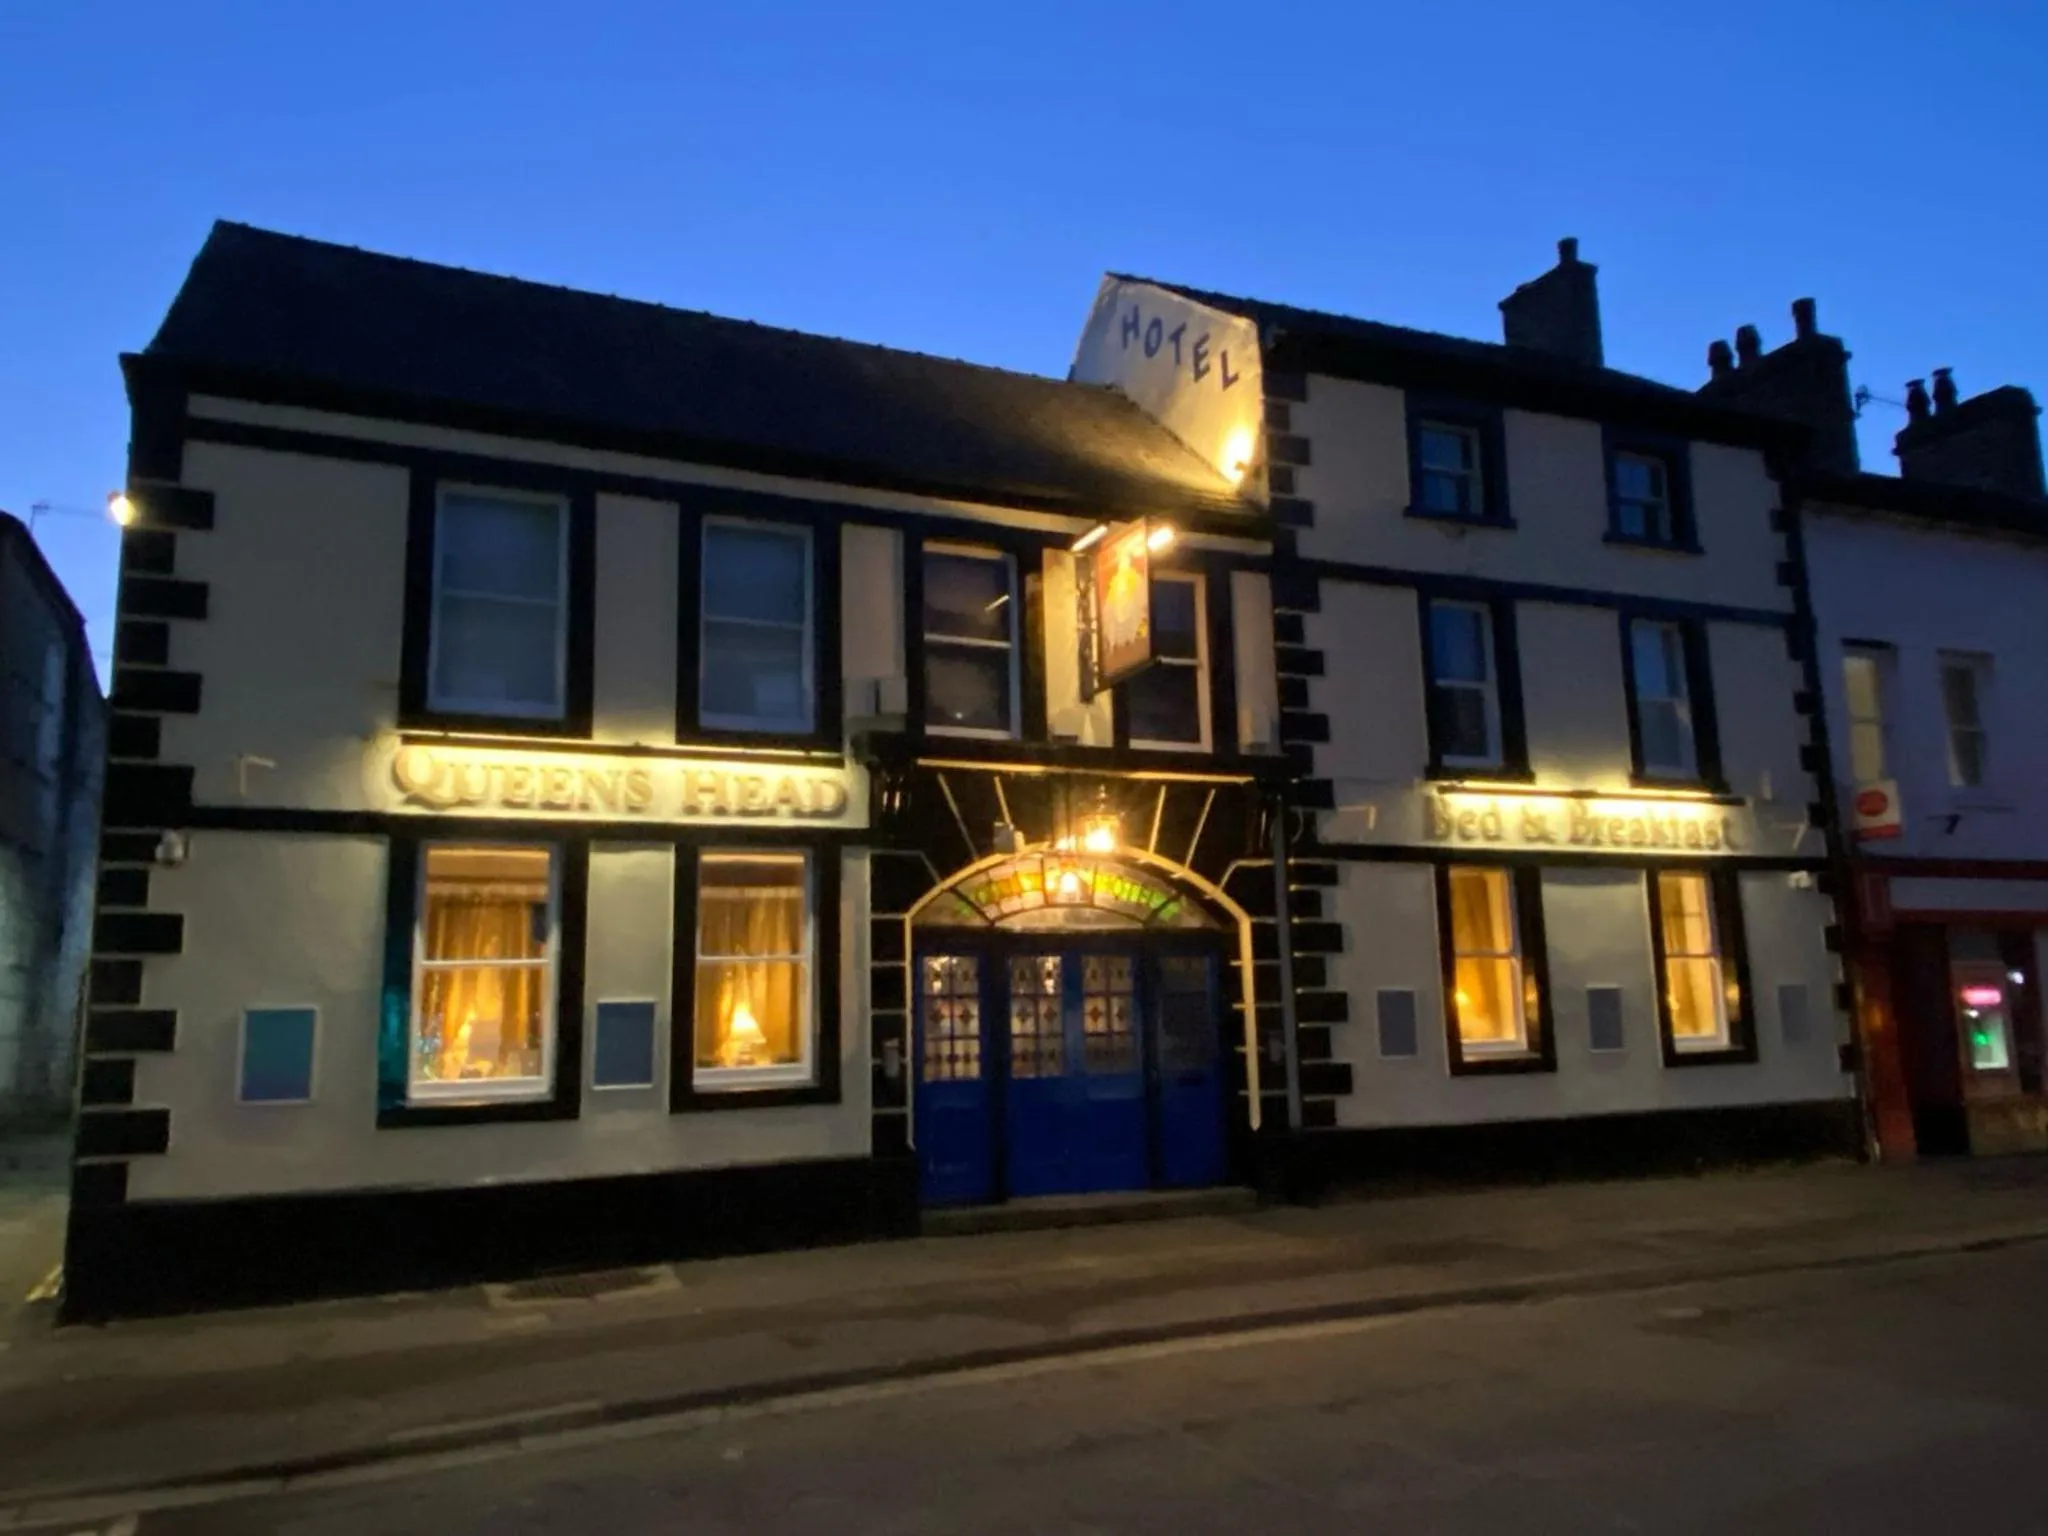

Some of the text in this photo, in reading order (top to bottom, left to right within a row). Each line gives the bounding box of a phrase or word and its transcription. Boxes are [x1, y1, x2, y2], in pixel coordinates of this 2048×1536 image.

[1121, 305, 1239, 391] HOTEL
[394, 746, 848, 818] QUEENS HEAD
[1426, 795, 1503, 842] Bed
[1522, 804, 1556, 844] &
